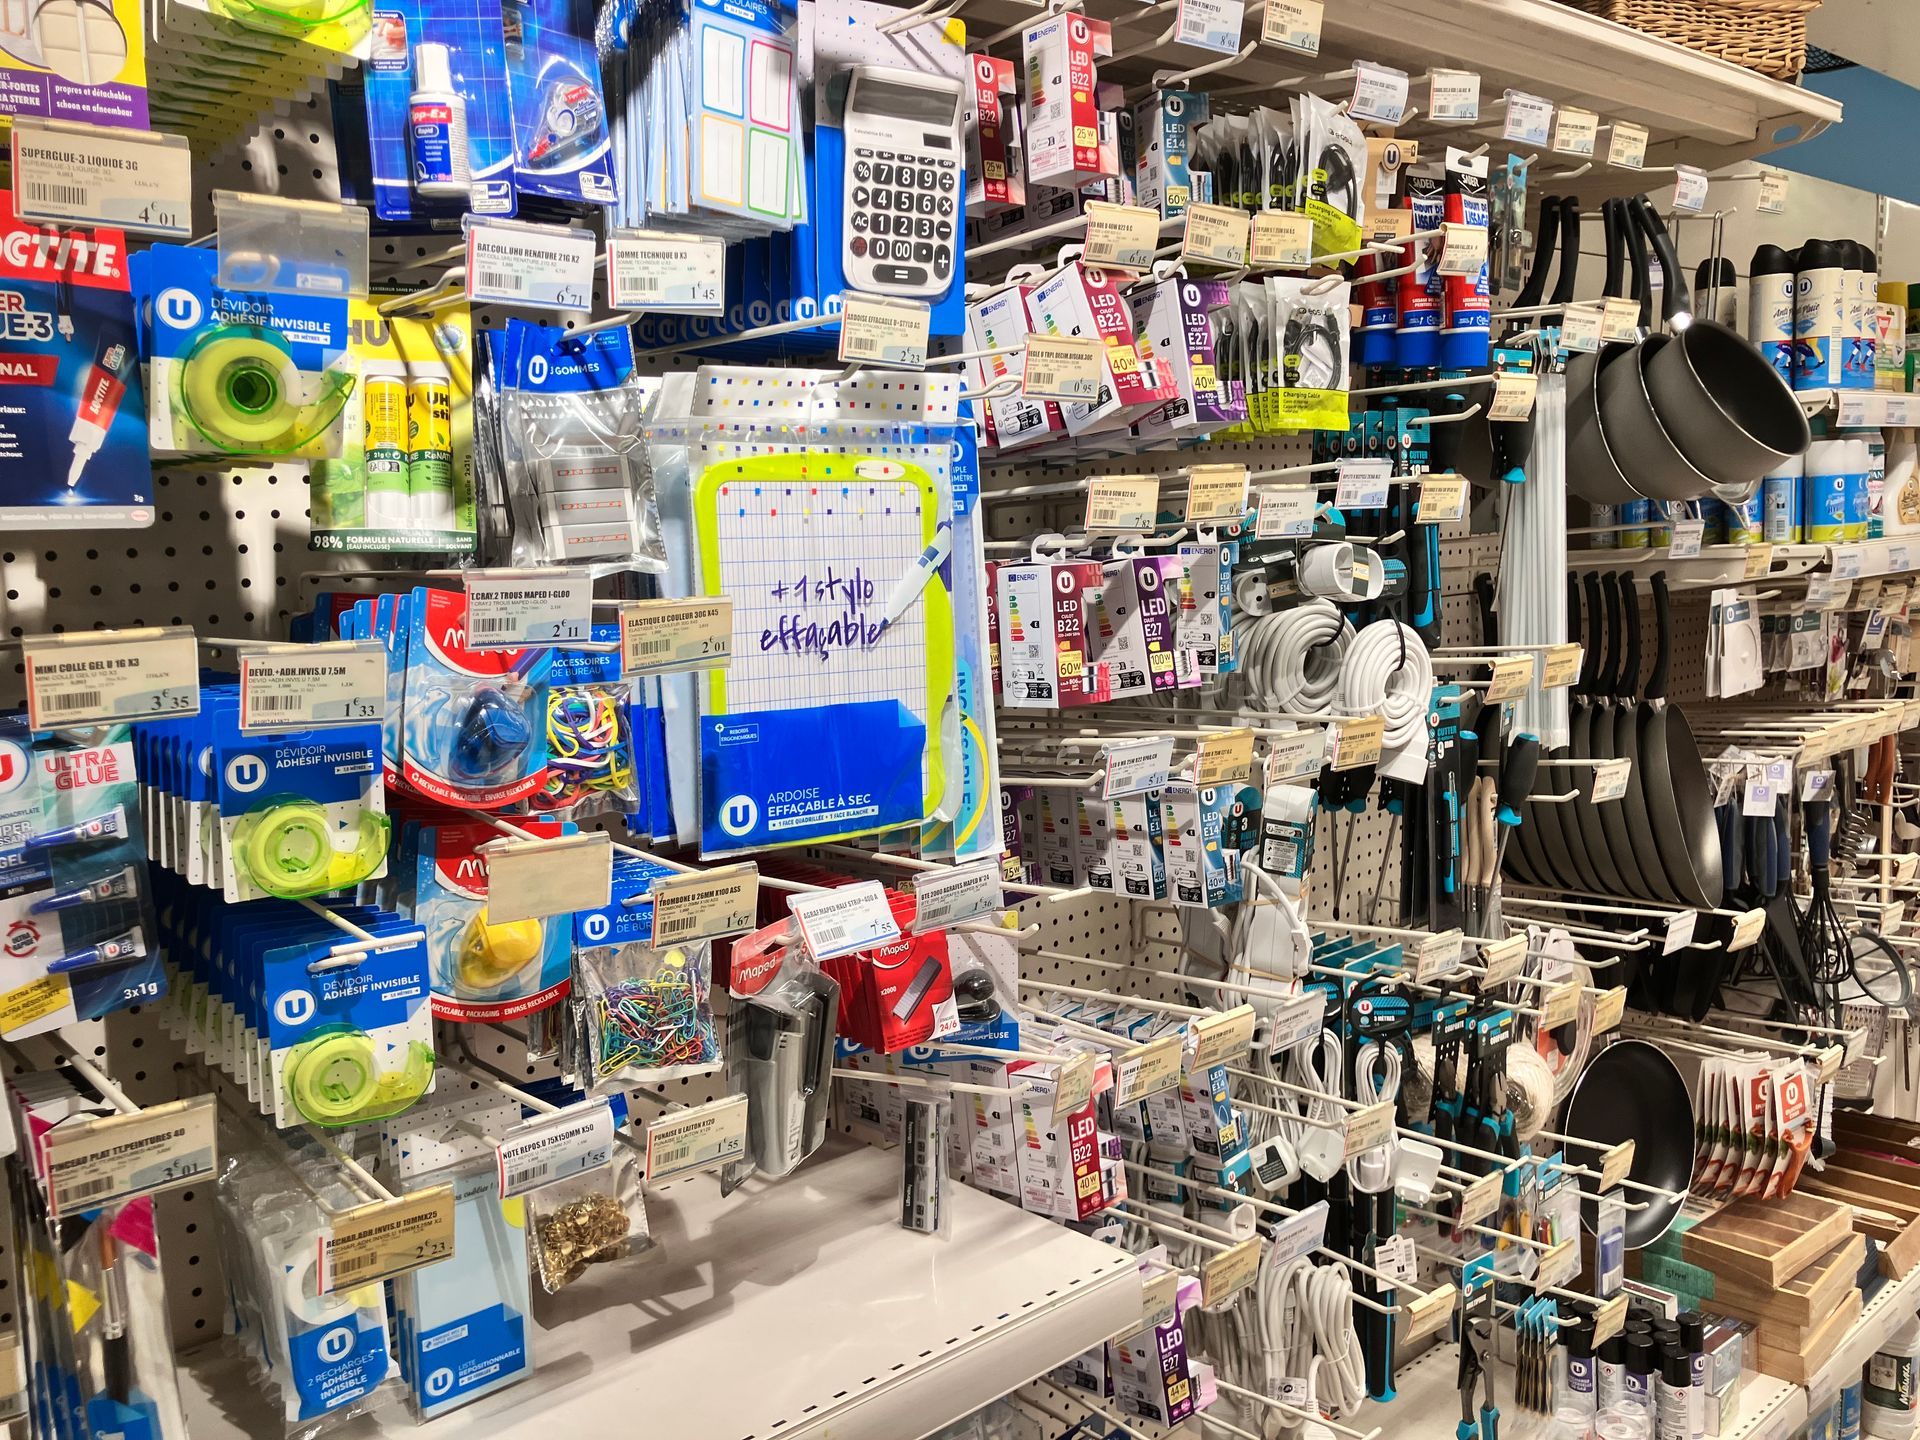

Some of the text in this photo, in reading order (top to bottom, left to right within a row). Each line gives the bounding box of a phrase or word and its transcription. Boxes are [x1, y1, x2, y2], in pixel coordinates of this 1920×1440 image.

[1071, 51, 1088, 66] LED
[1071, 72, 1090, 87] B22
[978, 88, 995, 105] LED
[979, 110, 997, 124] B22
[1165, 123, 1185, 134] LED
[1165, 138, 1185, 150] E14
[21, 147, 85, 164] SUPERGLUE-3
[87, 155, 123, 168] LIQUIDE
[125, 160, 138, 171] 3G
[880, 165, 889, 182] 7
[902, 168, 911, 185] 8
[924, 170, 933, 187] 9
[1412, 177, 1436, 190] SADER
[877, 190, 931, 212] 4 5 6
[855, 215, 930, 236] AC 1 2 3
[524, 247, 558, 260] RENATURE
[559, 252, 571, 262] 21G
[571, 254, 580, 264] X2
[616, 250, 638, 260] GOMME
[638, 251, 673, 261] TECHNIQUE
[679, 251, 688, 260] X3
[876, 240, 911, 258] 0 00
[211, 296, 274, 314] DÉVIDOIR
[1091, 294, 1117, 308] LED
[210, 308, 331, 333] ADHÉSIF INVISIBLE
[1097, 313, 1124, 328] B22
[1185, 313, 1206, 326] LED
[1188, 332, 1208, 345] E27
[555, 362, 600, 376] GOMMES
[1113, 357, 1138, 371] 40W
[1194, 376, 1216, 389] 40W
[90, 377, 110, 415] LOCTITE
[1283, 391, 1308, 399] Charging
[313, 535, 433, 549] 98% FORMULE NATURELLE
[456, 536, 472, 544] SANS
[500, 591, 523, 600] TROUS
[523, 591, 547, 599] MAPED
[548, 590, 570, 599] I-GLOO
[815, 567, 875, 614] stylo
[1057, 600, 1078, 613] LED
[1141, 597, 1165, 616] LED
[628, 616, 660, 628] ELASTIQUE
[666, 613, 692, 625] COULEUR
[707, 608, 719, 618] X45
[1057, 619, 1079, 632] B22
[760, 611, 882, 662] effaçable
[1145, 623, 1162, 637] E27
[34, 664, 57, 676] MINI
[59, 661, 88, 673] COLLE
[90, 659, 105, 671] GEL
[128, 658, 140, 668] X3
[552, 656, 610, 668] ACCESSOIRES
[1060, 662, 1082, 675] 60W
[552, 665, 601, 677] DE BUREAU
[275, 745, 326, 759] DÉVIDOIR
[275, 749, 374, 769] ADHÉSIF INVISIBLE
[45, 748, 117, 774] ULTRA
[56, 762, 120, 791] GLUE
[767, 787, 820, 803] ARDOISE
[768, 793, 871, 818] EFFAÇABLE À SEC
[1203, 811, 1218, 822] LED
[1204, 825, 1219, 837] E14
[963, 879, 978, 891] MAPED
[659, 894, 690, 907] TROMBONE
[697, 890, 717, 901] 26MM
[717, 888, 729, 897] X100
[730, 885, 741, 895] ASS
[879, 940, 911, 958] Maped
[738, 956, 777, 984] Maped
[124, 981, 158, 1000] 3x1g
[323, 973, 374, 991] DÉVIDOIR
[324, 974, 420, 1001] ADHÉSIF INVISIBLE
[880, 985, 897, 996] x2000
[939, 1020, 957, 1032] 24/6
[655, 1127, 677, 1142] PUNAISE
[682, 1121, 701, 1135] LAITON
[701, 1117, 715, 1130] X120
[1070, 1116, 1095, 1142] LED
[503, 1146, 519, 1159] NOTE
[547, 1127, 581, 1146] 75X150MM
[581, 1123, 594, 1135] X50
[89, 1149, 112, 1162] PLAT
[1073, 1144, 1092, 1162] B22
[1159, 1328, 1183, 1352] LED
[315, 1353, 374, 1384] RECHARGES
[458, 1347, 521, 1378] REPOSITIONNABLE
[458, 1358, 476, 1371] LISTE
[1162, 1355, 1179, 1372] E27
[320, 1374, 368, 1400] INVISIBLE
[321, 1366, 363, 1391] ADHÉSIF
